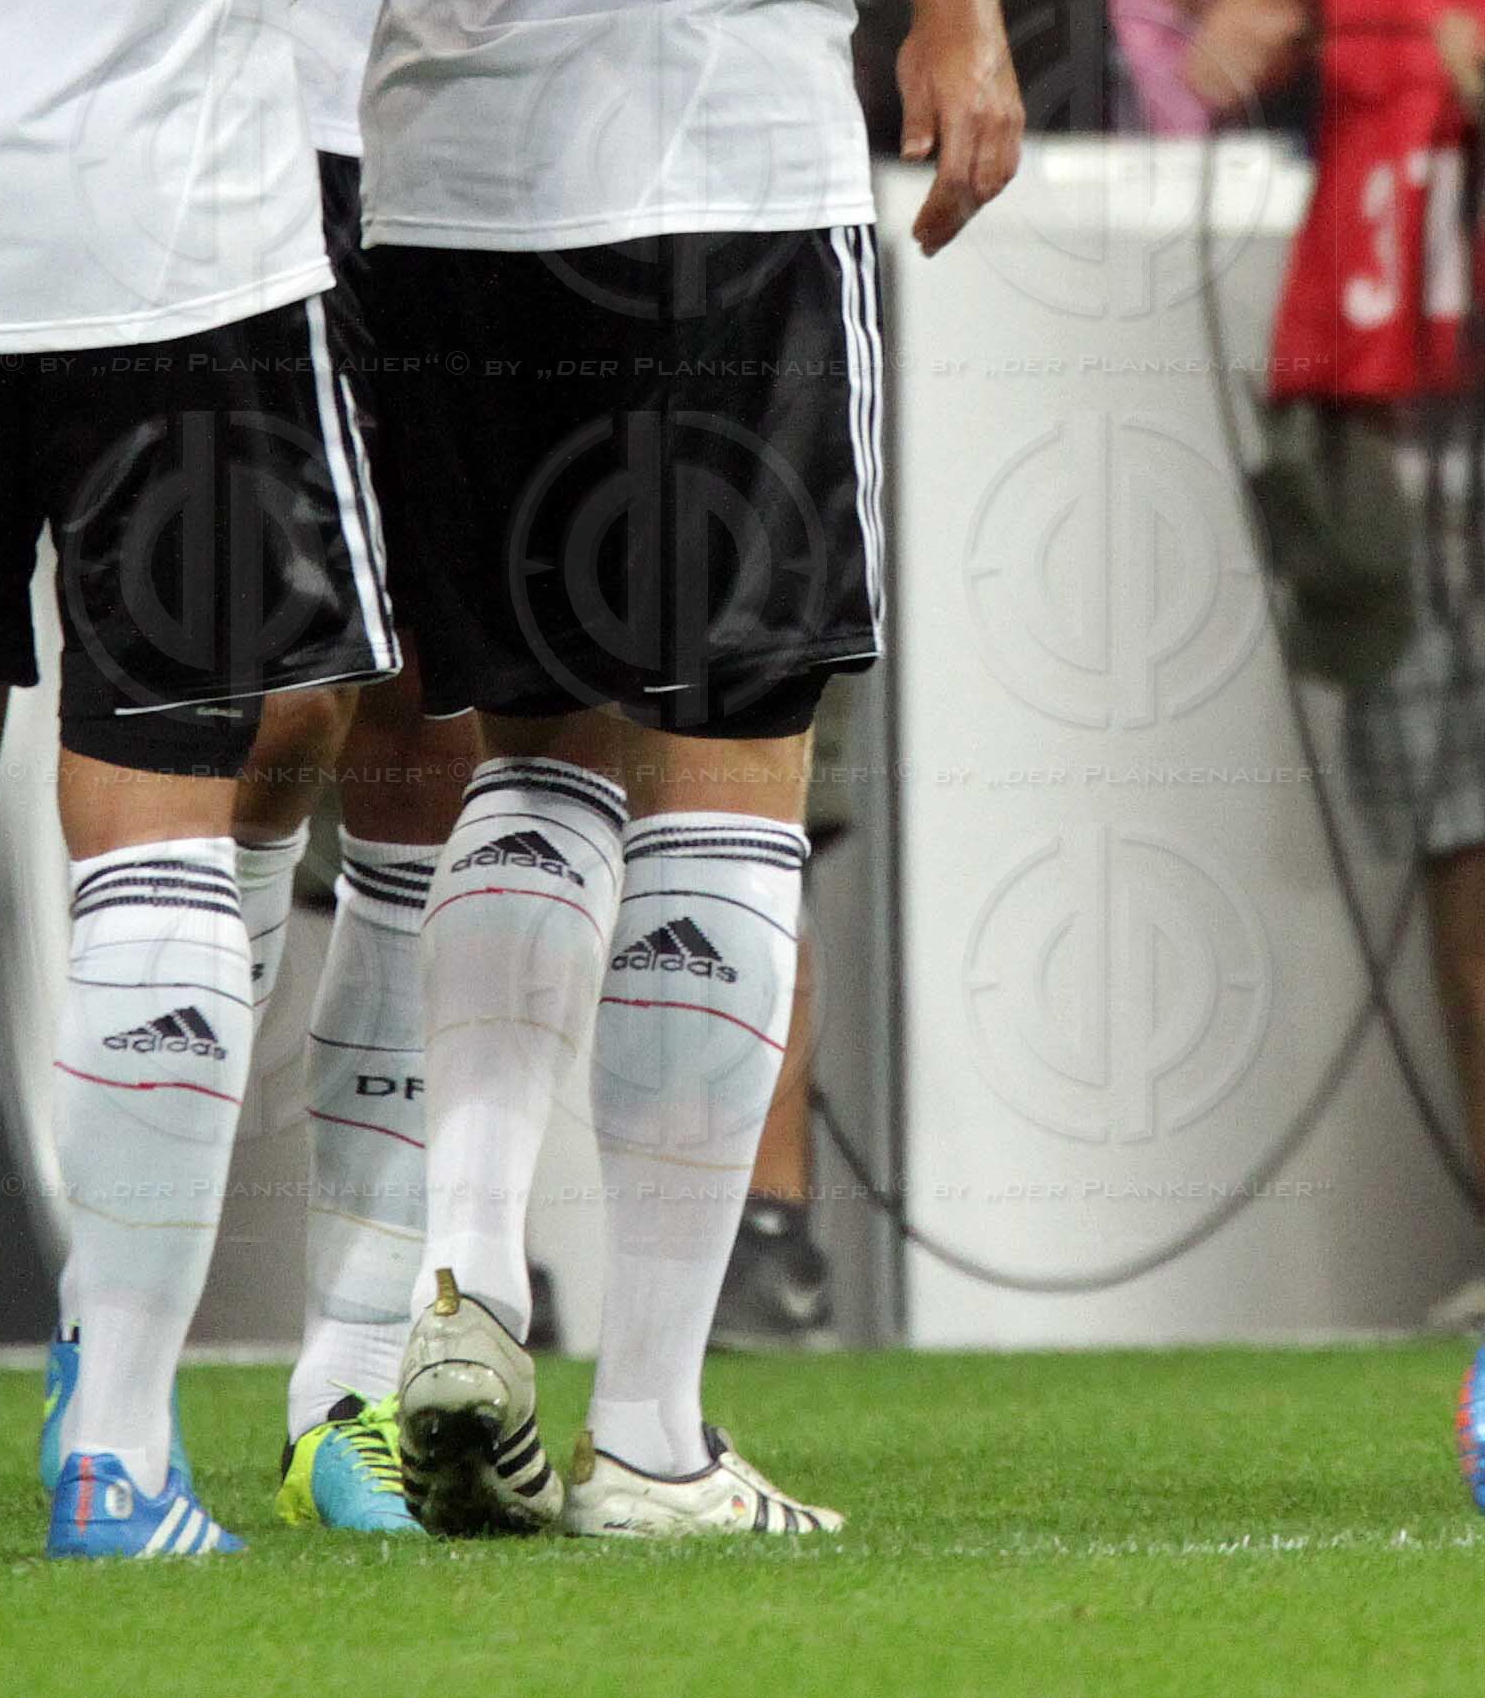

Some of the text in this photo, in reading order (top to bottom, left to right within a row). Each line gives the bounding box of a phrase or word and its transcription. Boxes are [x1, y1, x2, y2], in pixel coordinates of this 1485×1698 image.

[451, 850, 586, 888] adidas
[610, 950, 739, 983] adidas
[103, 1034, 228, 1060] adidas
